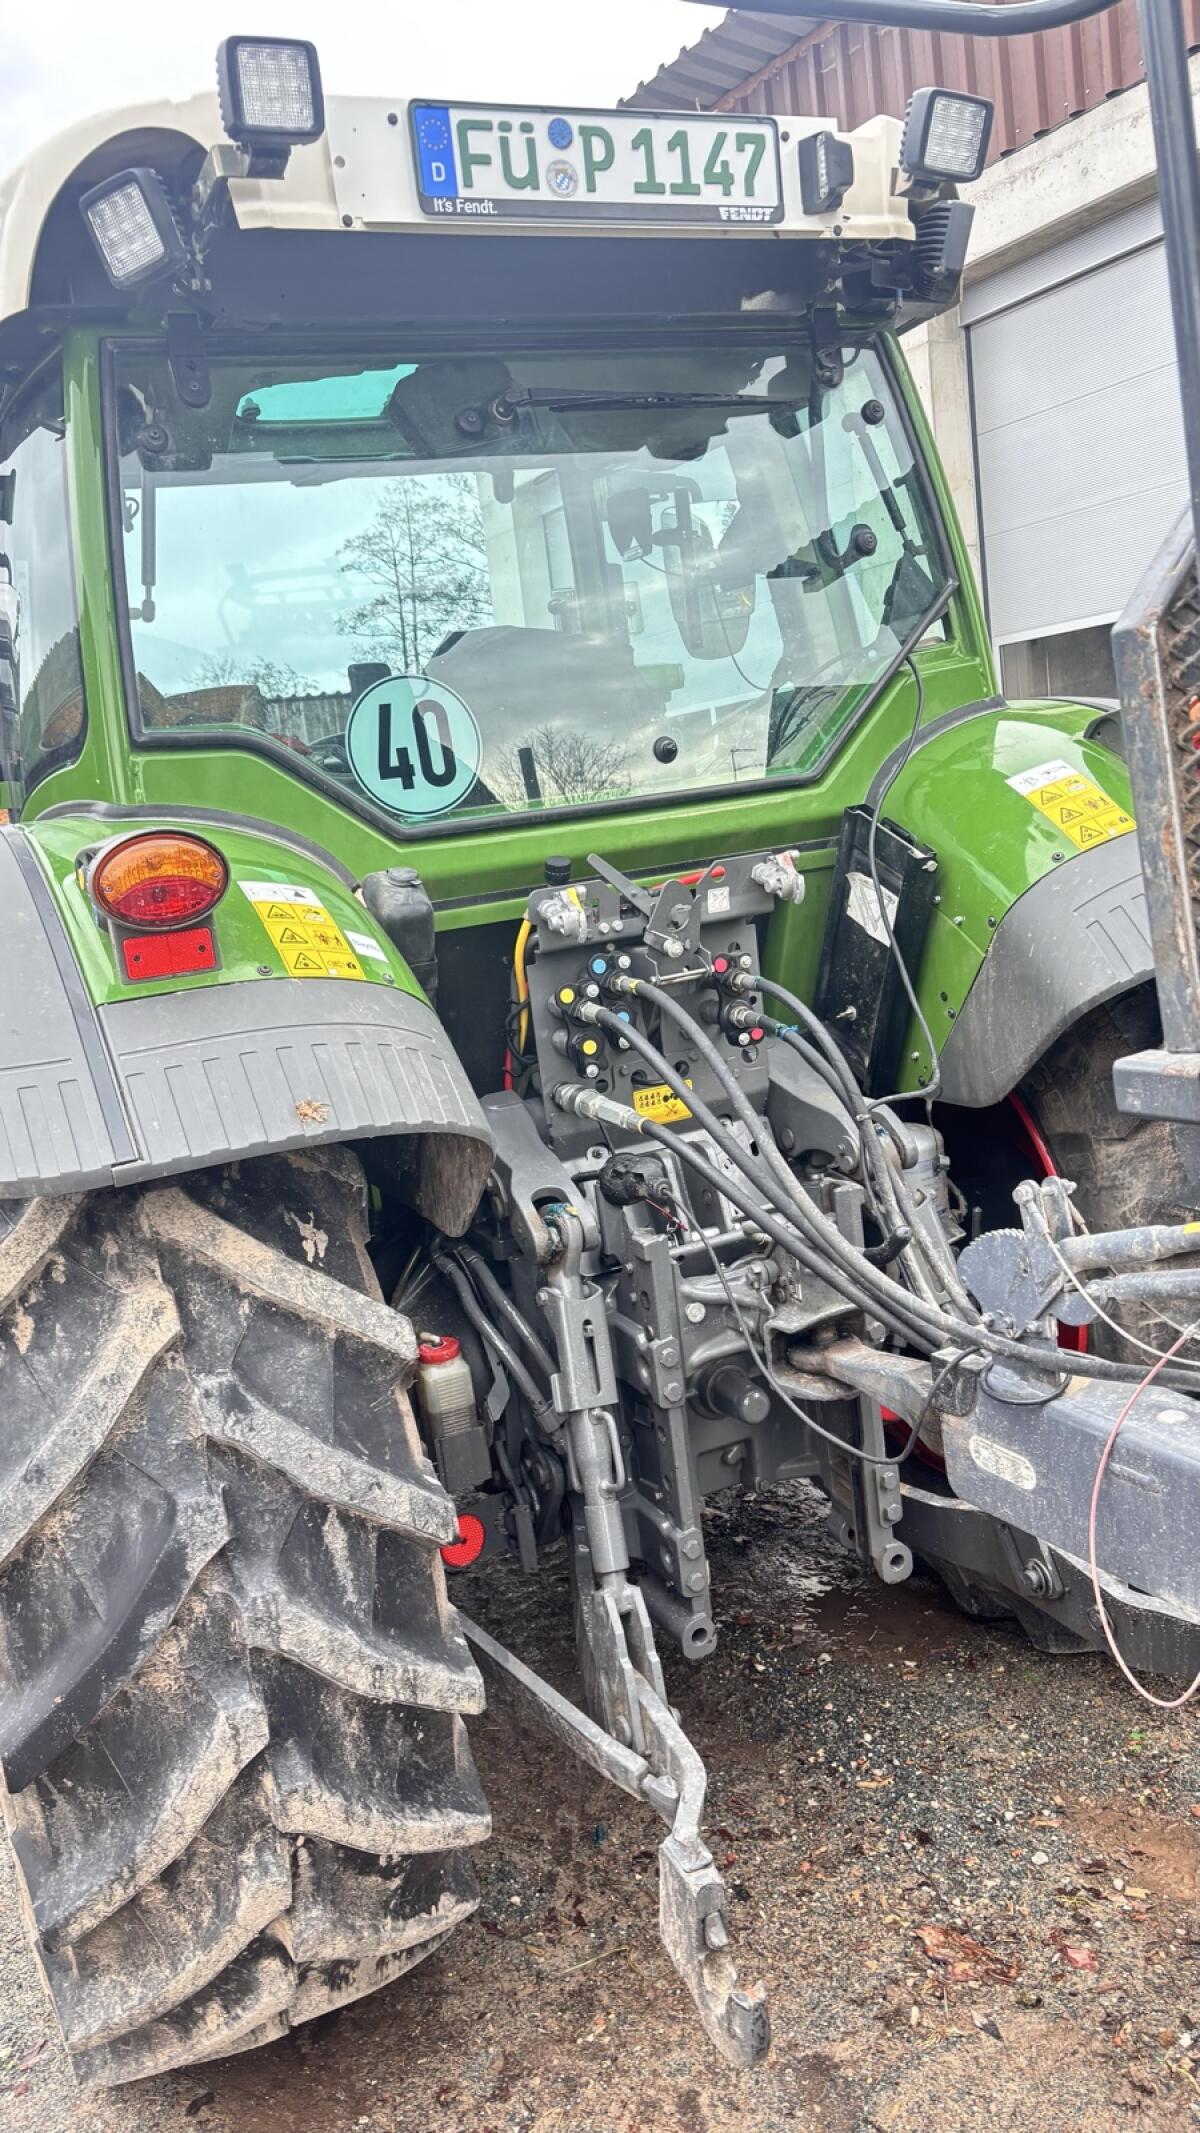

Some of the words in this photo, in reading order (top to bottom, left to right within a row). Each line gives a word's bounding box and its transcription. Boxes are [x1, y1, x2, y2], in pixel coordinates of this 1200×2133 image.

[455, 119, 540, 191] FÜ
[578, 125, 615, 192] P
[631, 128, 766, 196] 1147
[431, 162, 445, 182] D
[433, 197, 453, 213] It's
[456, 199, 498, 214] Fendt.
[719, 207, 774, 221] FENDT
[378, 699, 457, 790] 40
